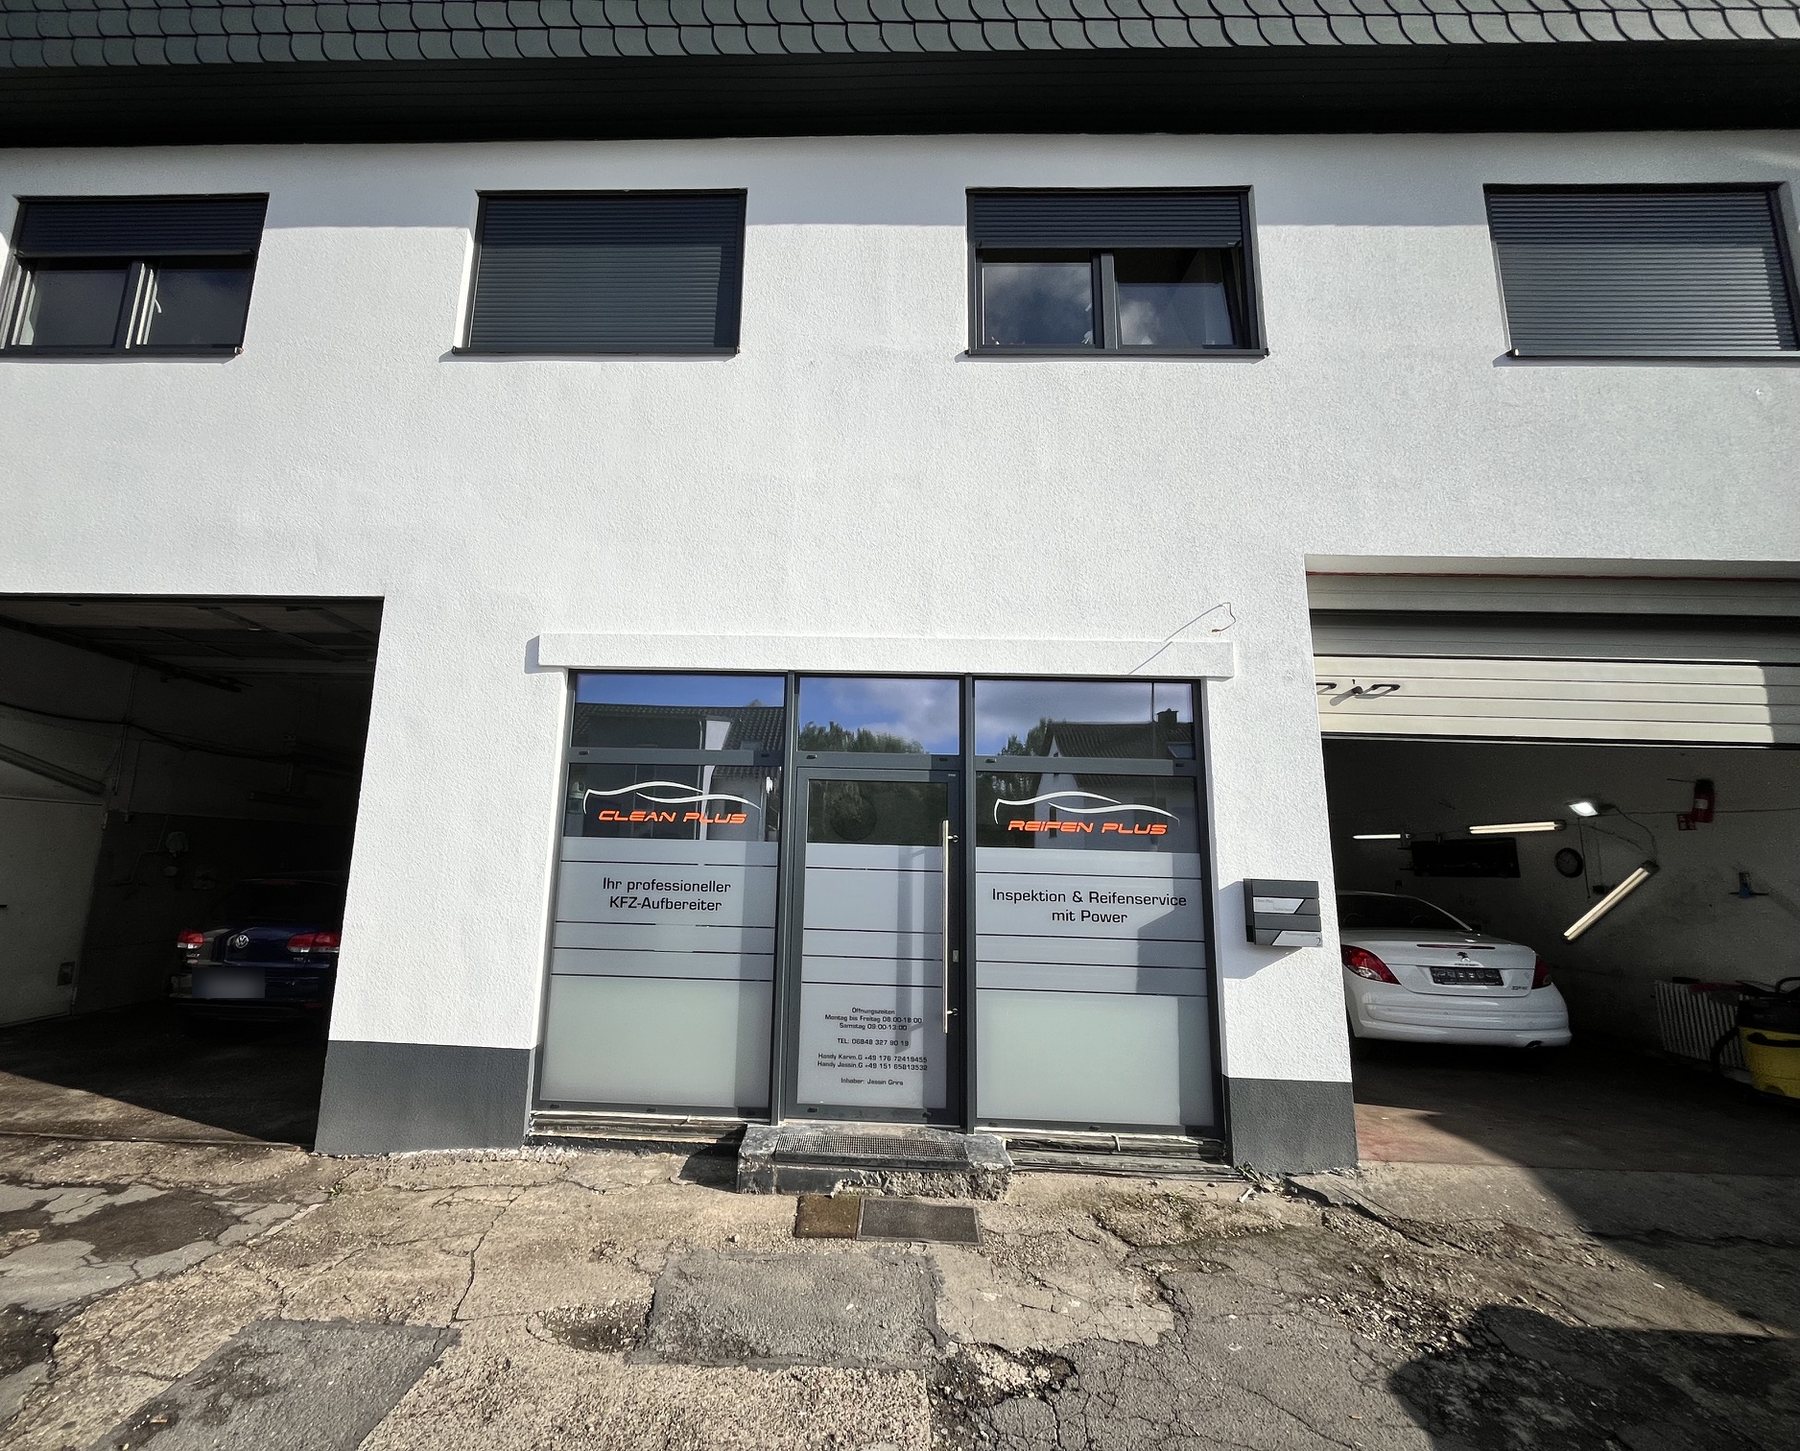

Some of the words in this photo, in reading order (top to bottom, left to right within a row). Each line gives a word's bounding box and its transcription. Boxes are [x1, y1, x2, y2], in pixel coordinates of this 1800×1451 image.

[598, 810, 676, 823] CLEAN
[682, 812, 748, 824] PLUS
[1007, 820, 1094, 833] REIFEN
[1101, 822, 1168, 835] PLUS
[603, 877, 622, 890] Ihr
[627, 879, 731, 895] professioneller
[609, 896, 722, 911] KFZ-Aufbereiter
[992, 888, 1066, 904] Inspektion
[1072, 890, 1084, 903] &
[1089, 891, 1187, 906] Reifenservice
[1052, 909, 1076, 922] mit
[1081, 910, 1128, 923] Power
[840, 1022, 865, 1030] Samstag
